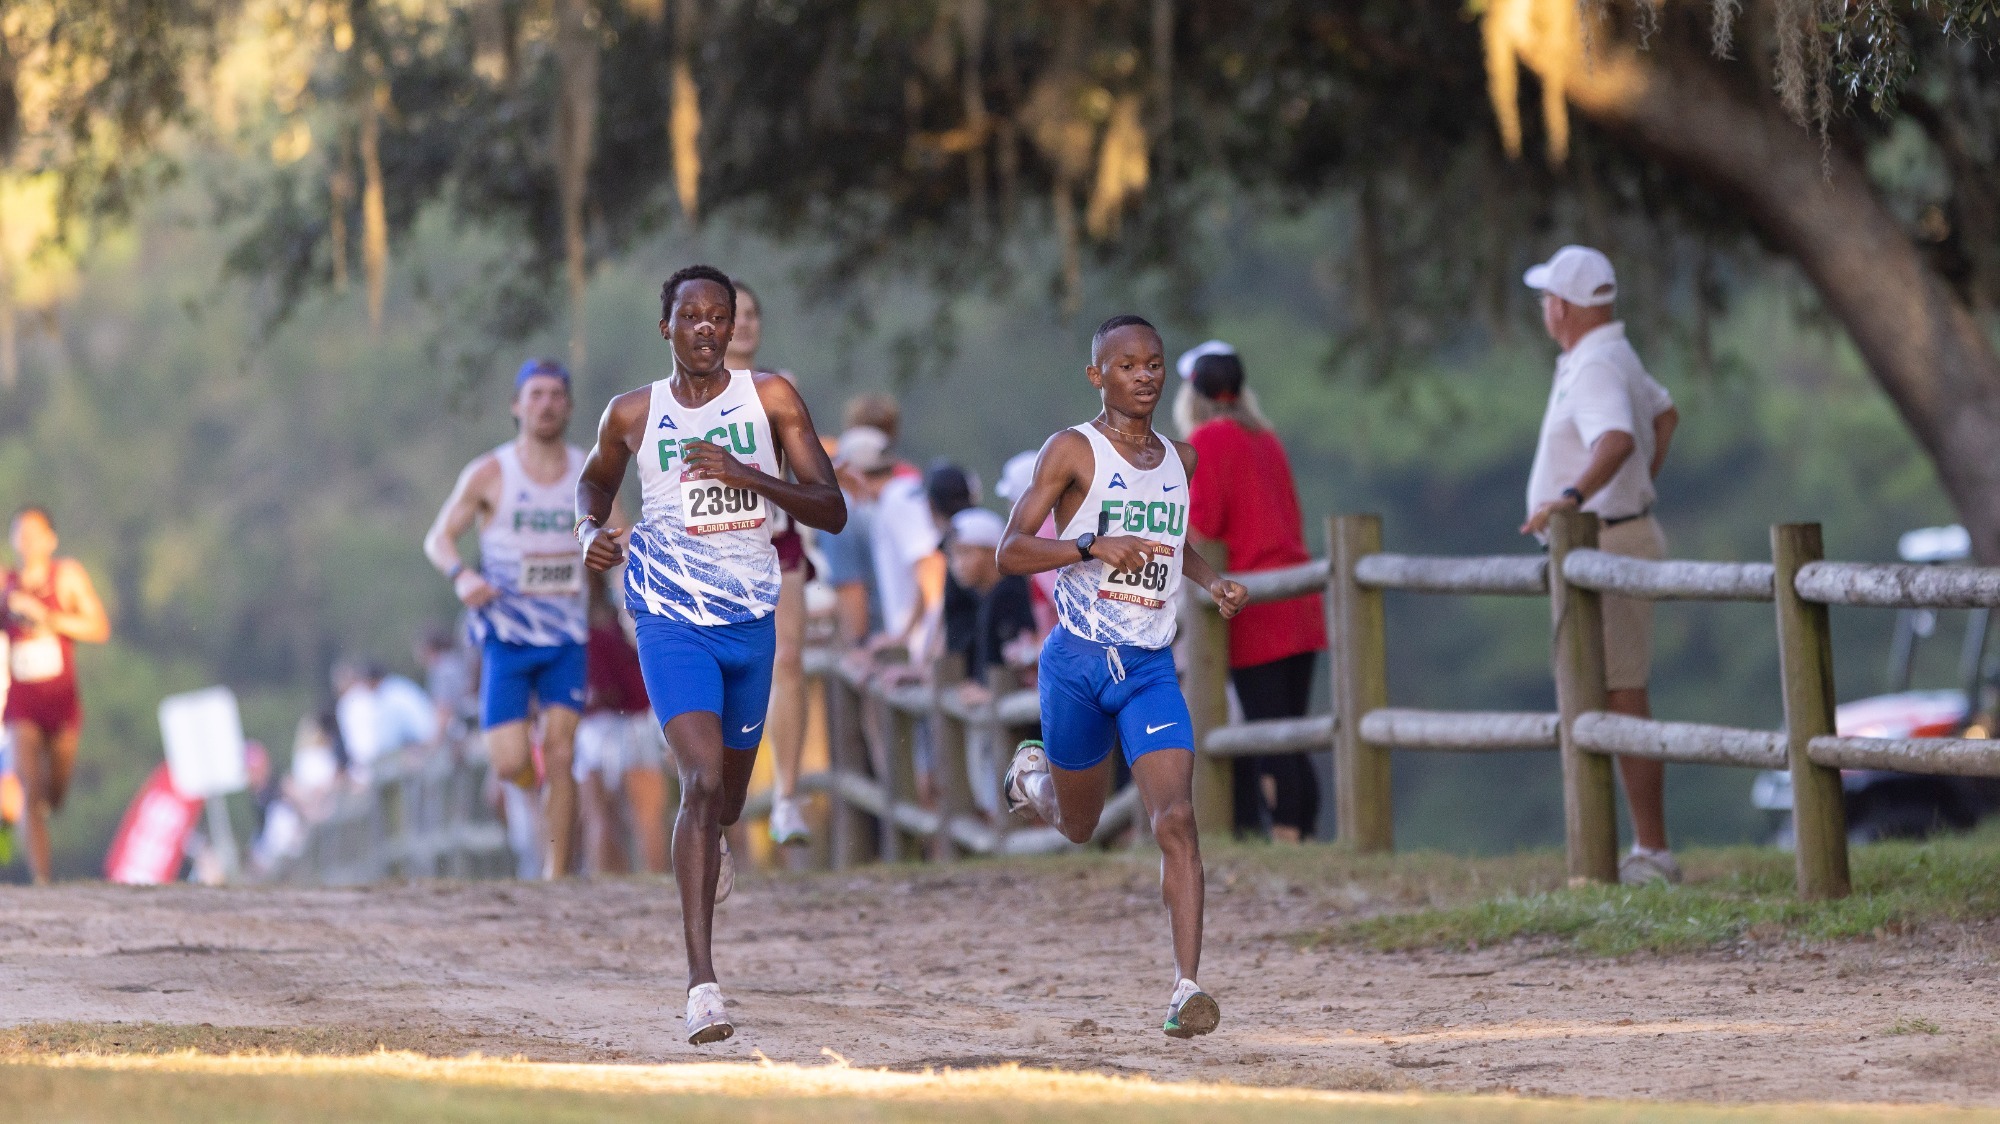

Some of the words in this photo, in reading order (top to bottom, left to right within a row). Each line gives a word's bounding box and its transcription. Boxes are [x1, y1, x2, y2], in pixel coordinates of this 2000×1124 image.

[688, 486, 758, 518] 2390
[697, 522, 730, 534] FLORIDA
[732, 519, 755, 530] STATE
[1102, 500, 1185, 536] FGCU
[1109, 592, 1141, 604] FLORIDA
